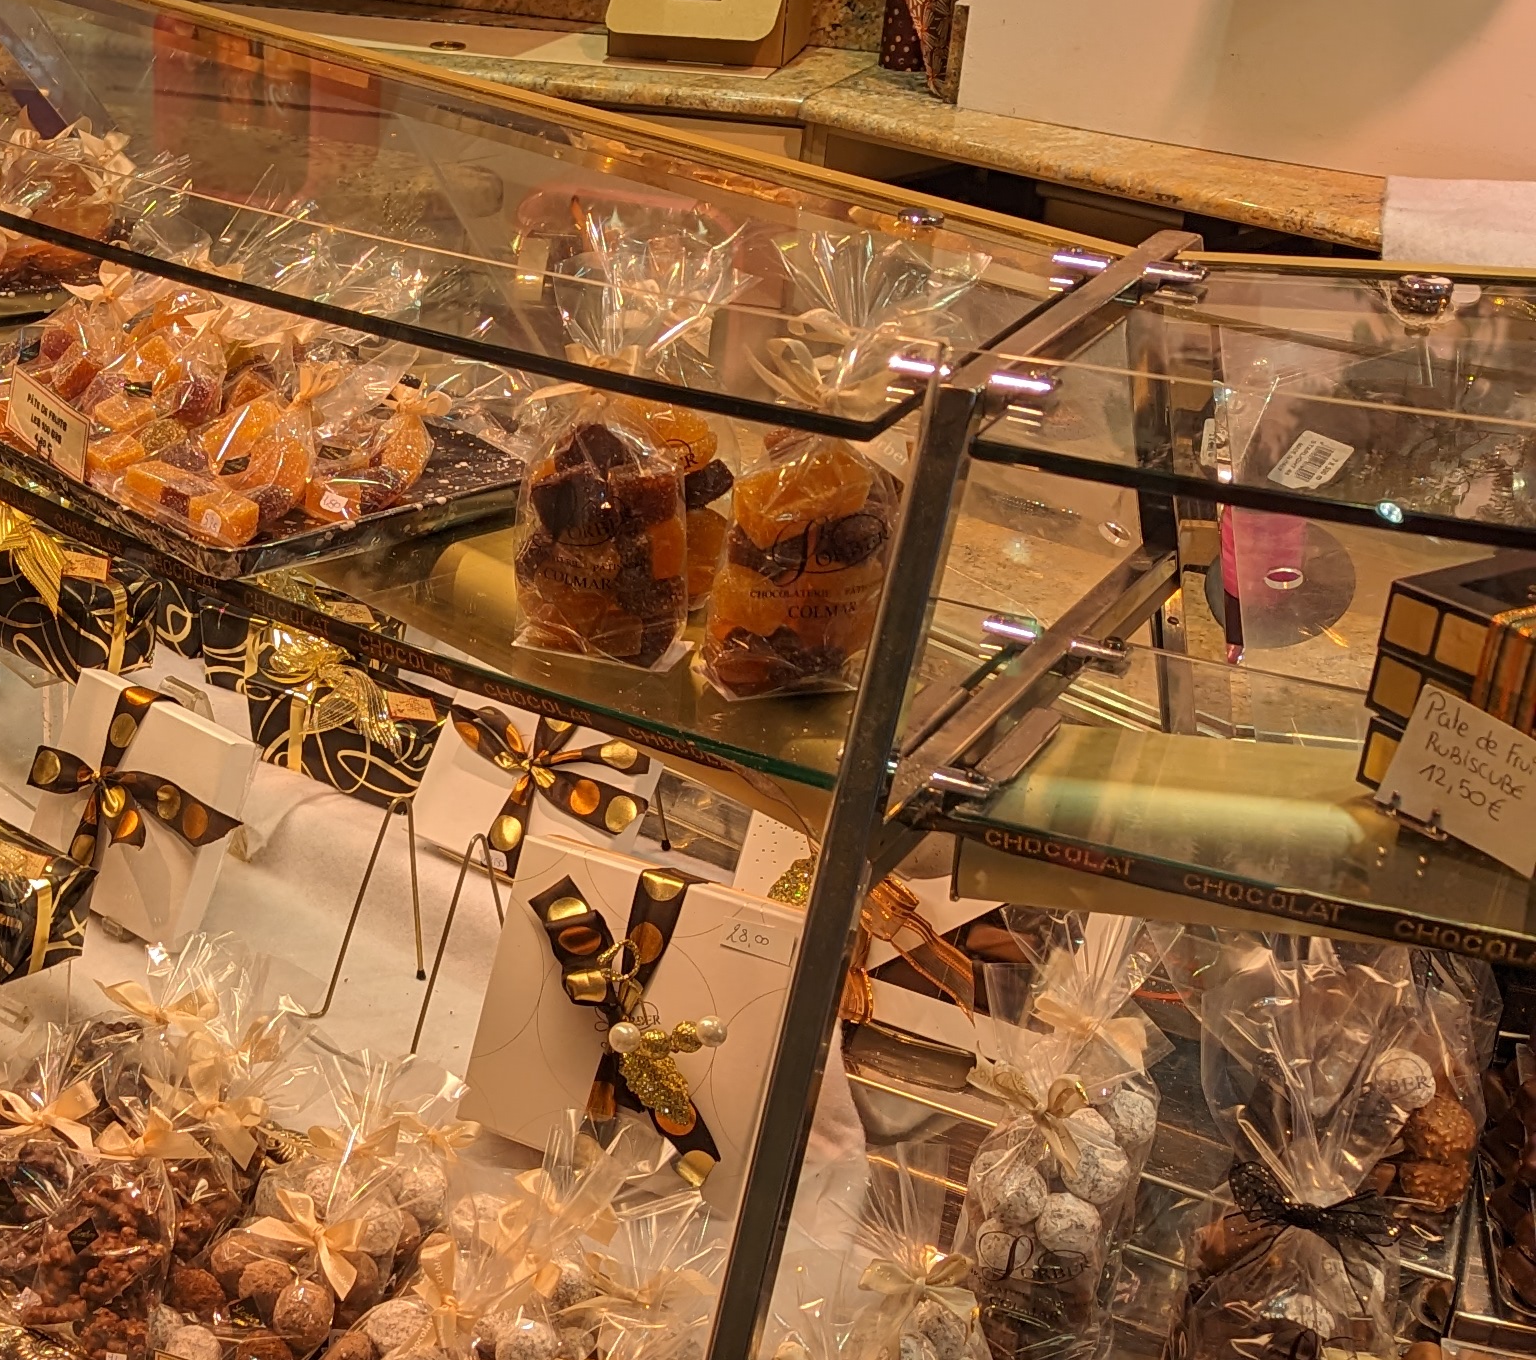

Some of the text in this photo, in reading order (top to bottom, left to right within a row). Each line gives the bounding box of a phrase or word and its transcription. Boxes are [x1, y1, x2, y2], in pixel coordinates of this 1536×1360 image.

[543, 567, 612, 591] COLMAR
[243, 590, 330, 636] CHOCOLAT
[787, 601, 857, 620] COLMAR
[358, 634, 452, 683] CHOCOLAT
[482, 682, 593, 726] CHOCOLAT
[1475, 729, 1498, 757] de
[984, 828, 1136, 877] CHOCOLAT
[1182, 873, 1346, 924] CHOCOLAT
